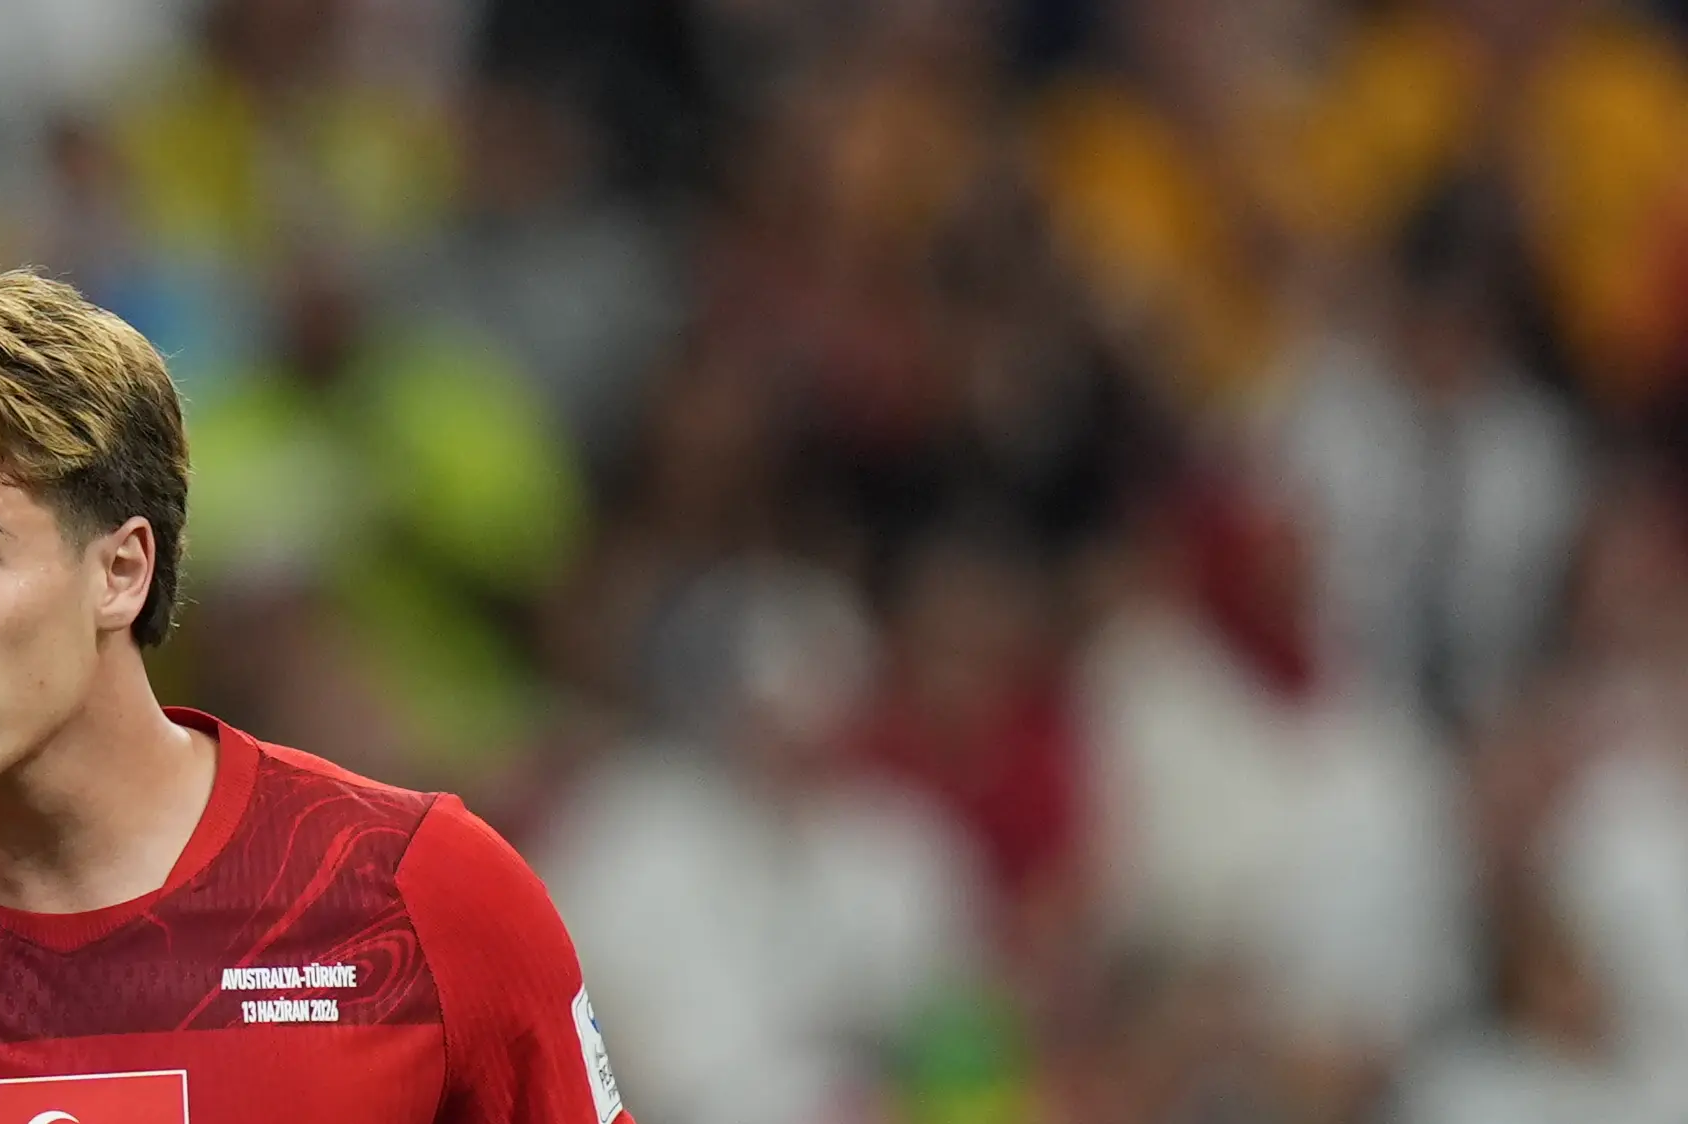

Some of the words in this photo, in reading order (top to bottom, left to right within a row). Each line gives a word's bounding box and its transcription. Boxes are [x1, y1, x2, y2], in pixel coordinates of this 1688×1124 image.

[221, 962, 357, 990] AVUSTRALYA-TÜRKİYE
[242, 1001, 256, 1023] 13
[258, 997, 309, 1022] HAZİRAN
[311, 999, 339, 1021] 2026
